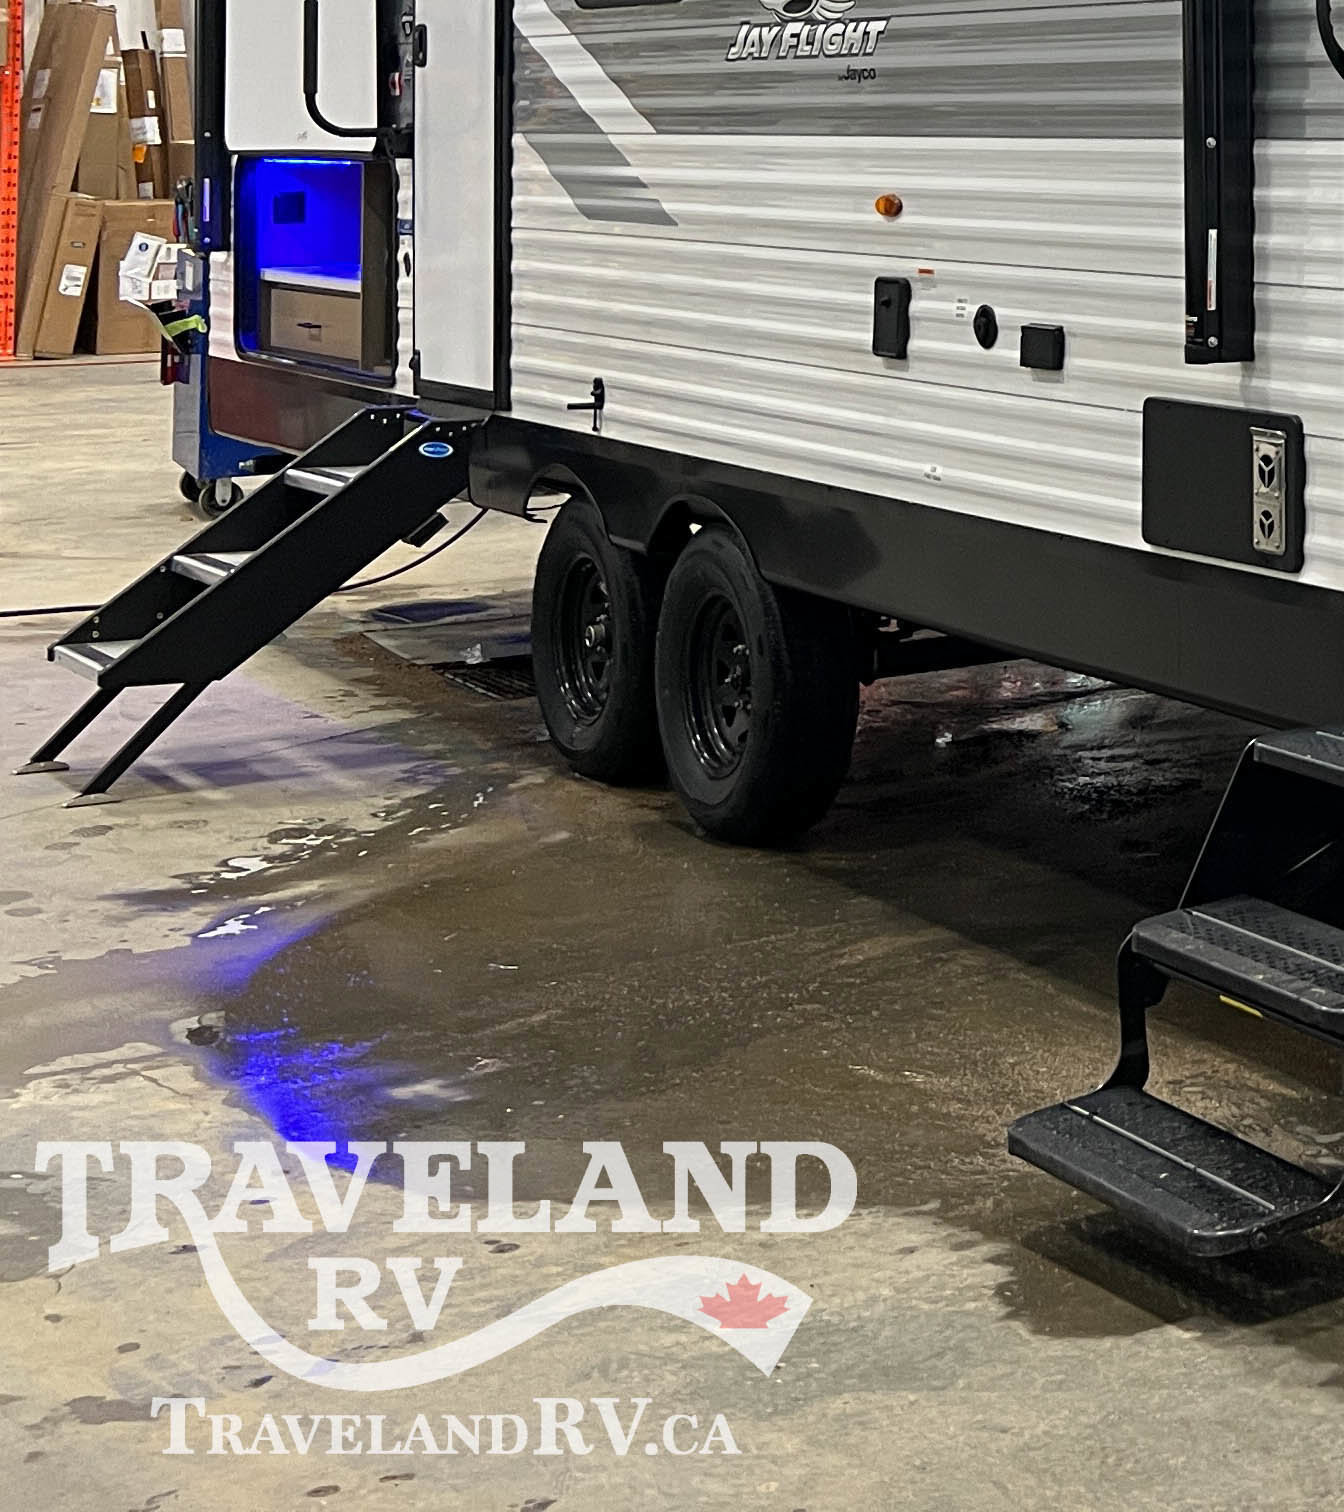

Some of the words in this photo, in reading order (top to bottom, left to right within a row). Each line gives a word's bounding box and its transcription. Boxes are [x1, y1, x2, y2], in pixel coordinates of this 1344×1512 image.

[727, 23, 780, 60] JAY
[778, 20, 888, 57] FLIGHT
[845, 66, 876, 82] Jayco
